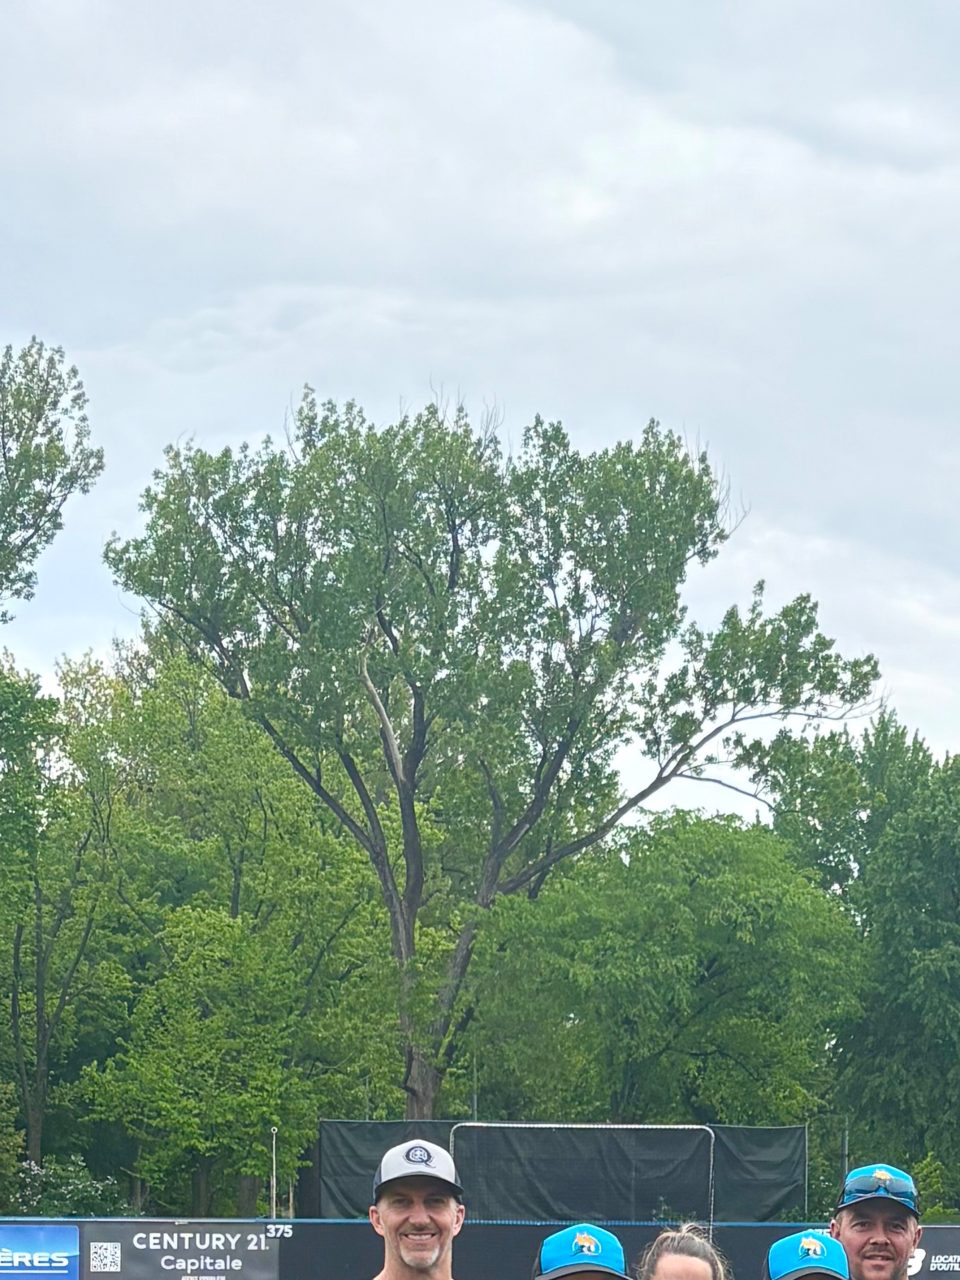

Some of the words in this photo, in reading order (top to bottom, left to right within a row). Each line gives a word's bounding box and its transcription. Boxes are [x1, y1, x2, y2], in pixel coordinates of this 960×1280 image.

[266, 1224, 293, 1238] 375
[132, 1232, 242, 1250] CENTURY
[160, 1255, 243, 1275] Capitale
